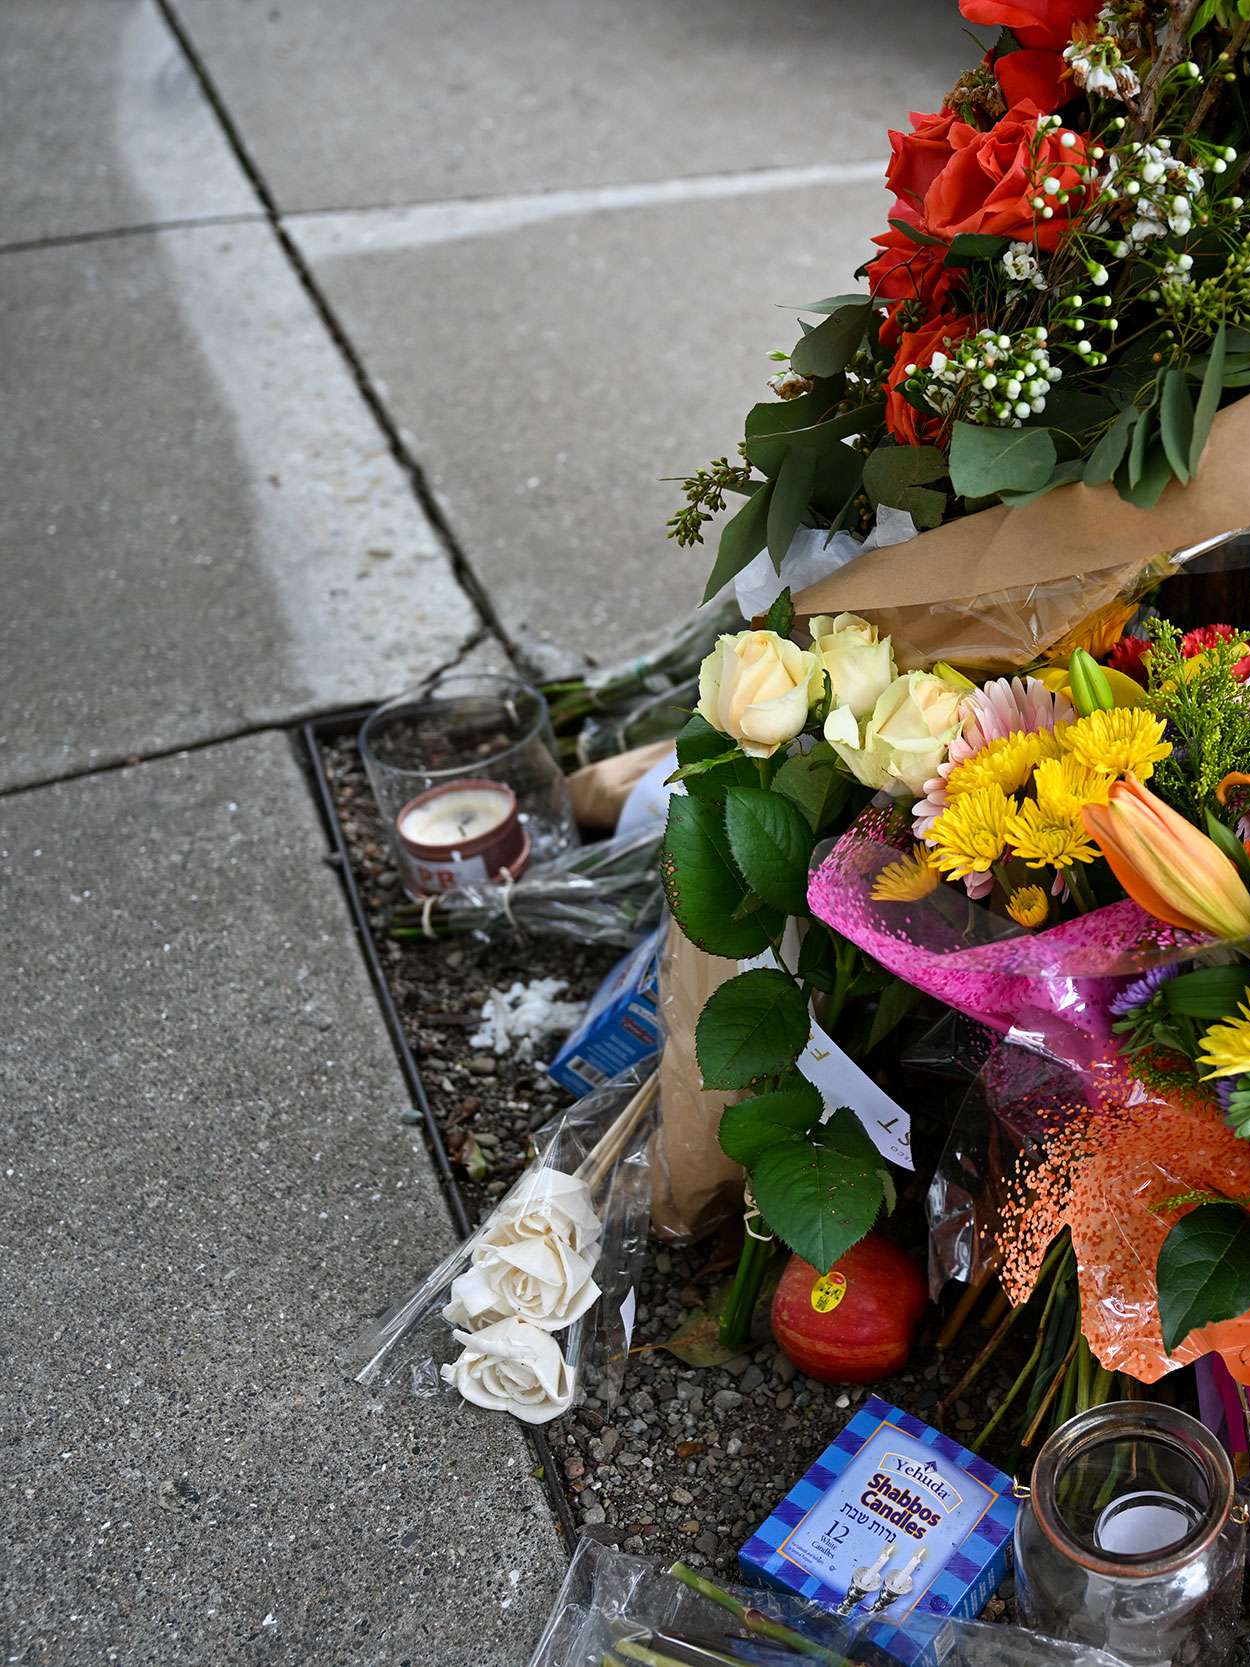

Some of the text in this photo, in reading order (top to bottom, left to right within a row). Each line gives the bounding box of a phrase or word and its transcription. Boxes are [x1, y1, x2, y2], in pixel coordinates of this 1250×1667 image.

[866, 1473, 942, 1527] Shabbos
[895, 1458, 949, 1500] Yehuda
[824, 1519, 850, 1544] 12
[840, 1502, 897, 1544] נרות שבת
[860, 1489, 927, 1540] Candles
[811, 1540, 835, 1559] Candles
[820, 1535, 838, 1551] White
